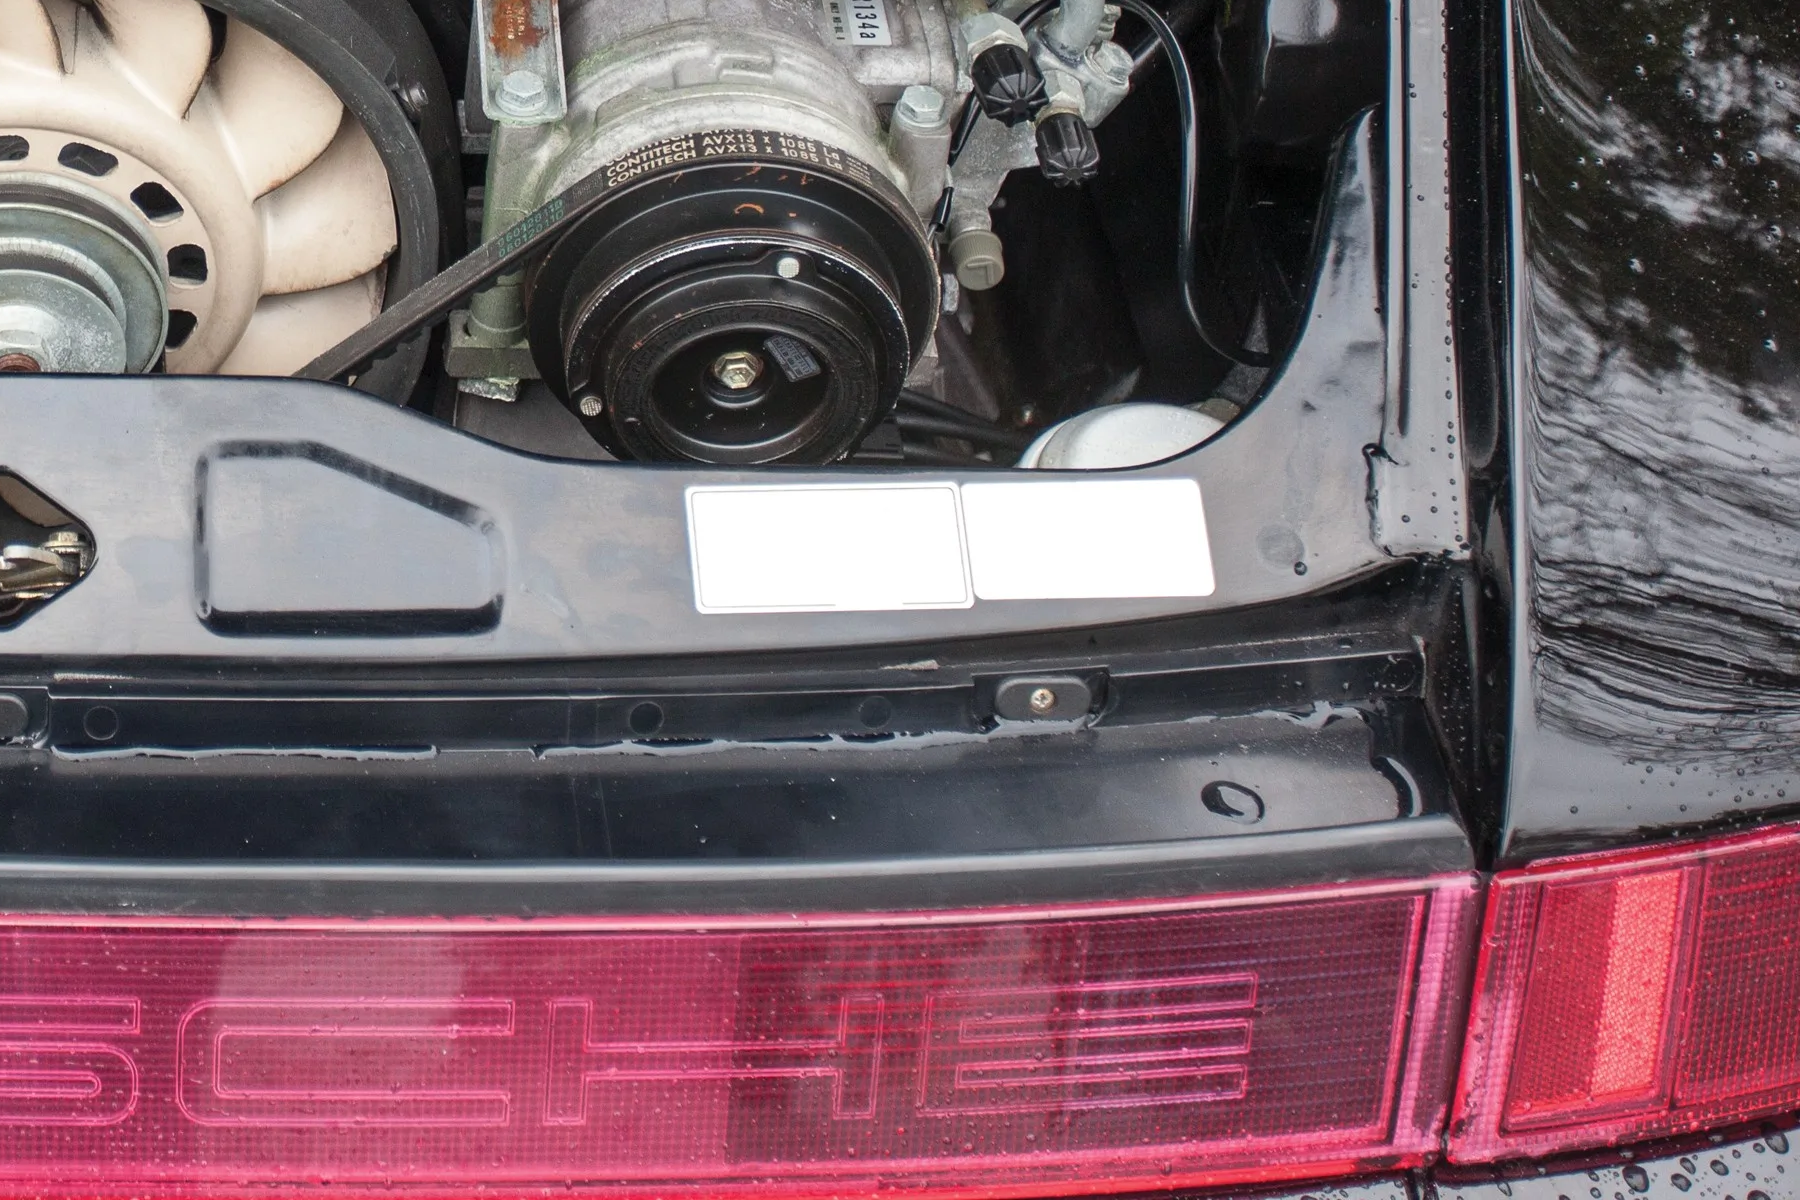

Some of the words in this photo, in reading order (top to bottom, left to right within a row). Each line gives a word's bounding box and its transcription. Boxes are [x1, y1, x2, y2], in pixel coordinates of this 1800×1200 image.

[606, 139, 695, 177] CONTITECH
[702, 133, 755, 146] AVX13
[763, 135, 770, 144] x
[778, 136, 817, 152] 1085
[608, 150, 697, 187] CONTITECH
[704, 144, 758, 156] AVX13
[765, 145, 773, 154] x
[781, 147, 819, 163] 1085
